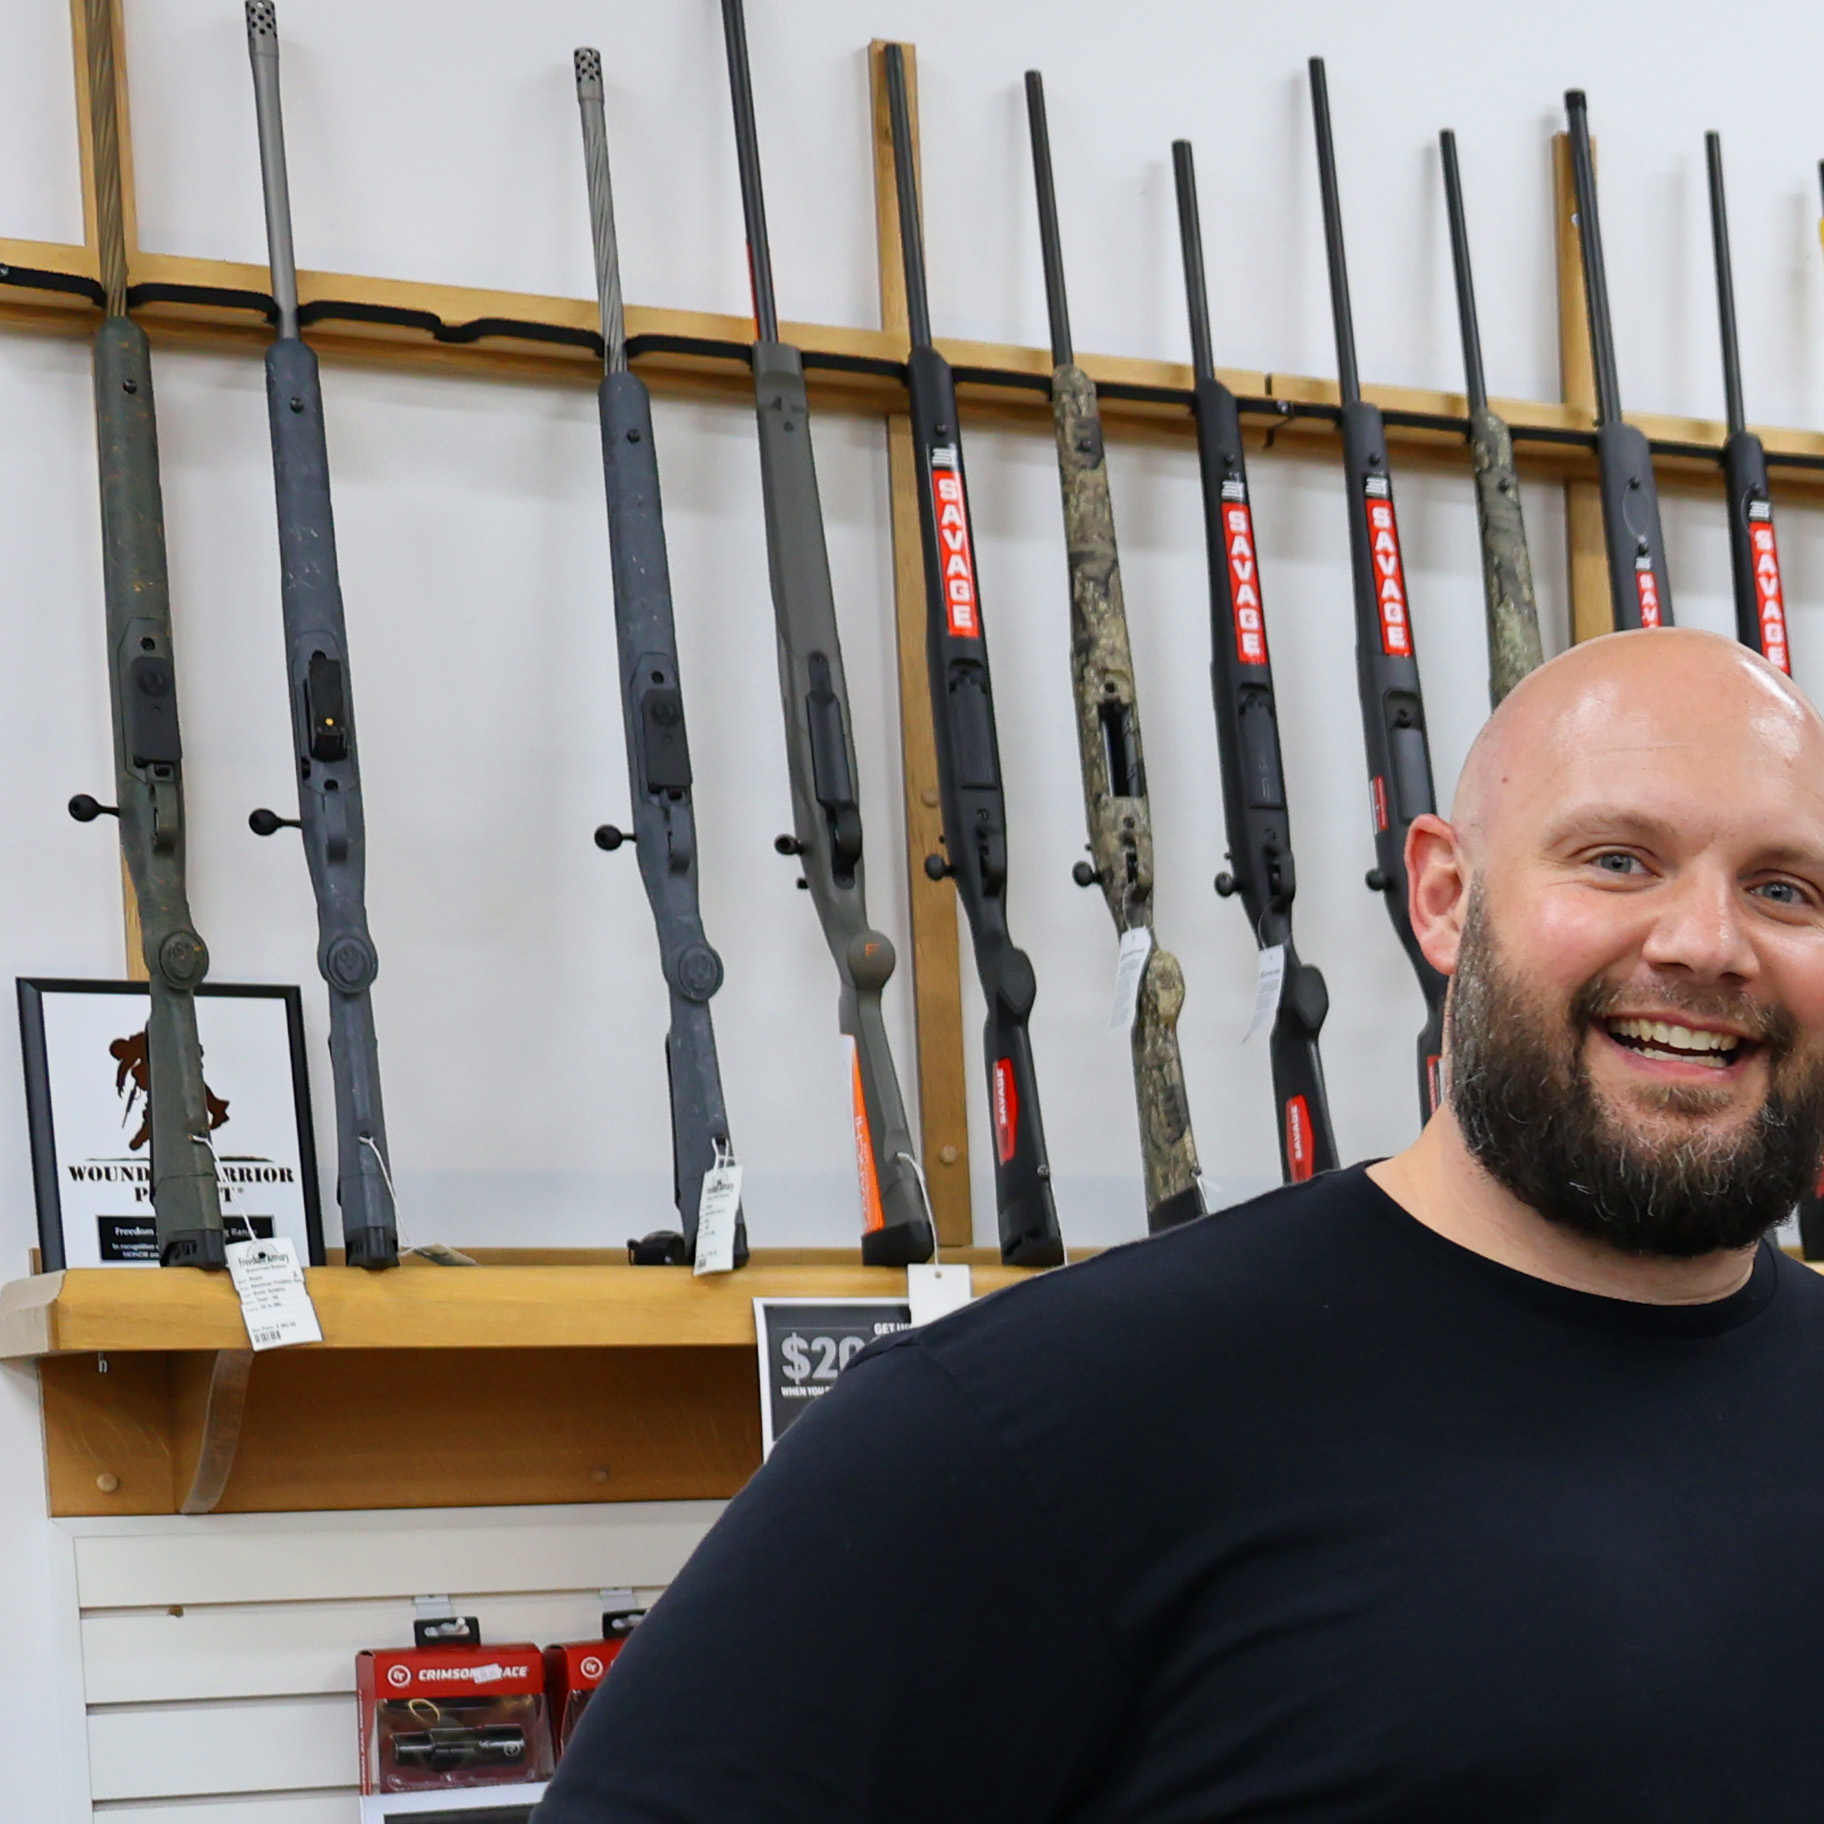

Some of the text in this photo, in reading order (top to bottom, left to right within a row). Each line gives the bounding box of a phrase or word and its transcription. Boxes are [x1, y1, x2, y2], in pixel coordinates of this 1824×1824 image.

[938, 478, 972, 627] SAVAGE
[1371, 506, 1405, 648] SAVAGE
[1228, 510, 1260, 654] SAVAGE
[1640, 574, 1658, 628] SAV
[1755, 530, 1786, 667] SAVAGE
[997, 1068, 1007, 1124] SAVAGE
[1290, 1104, 1303, 1159] SAVAGE
[115, 1226, 155, 1237] Freedom
[874, 1322, 896, 1336] GET
[781, 1386, 825, 1397] WHEN YOU
